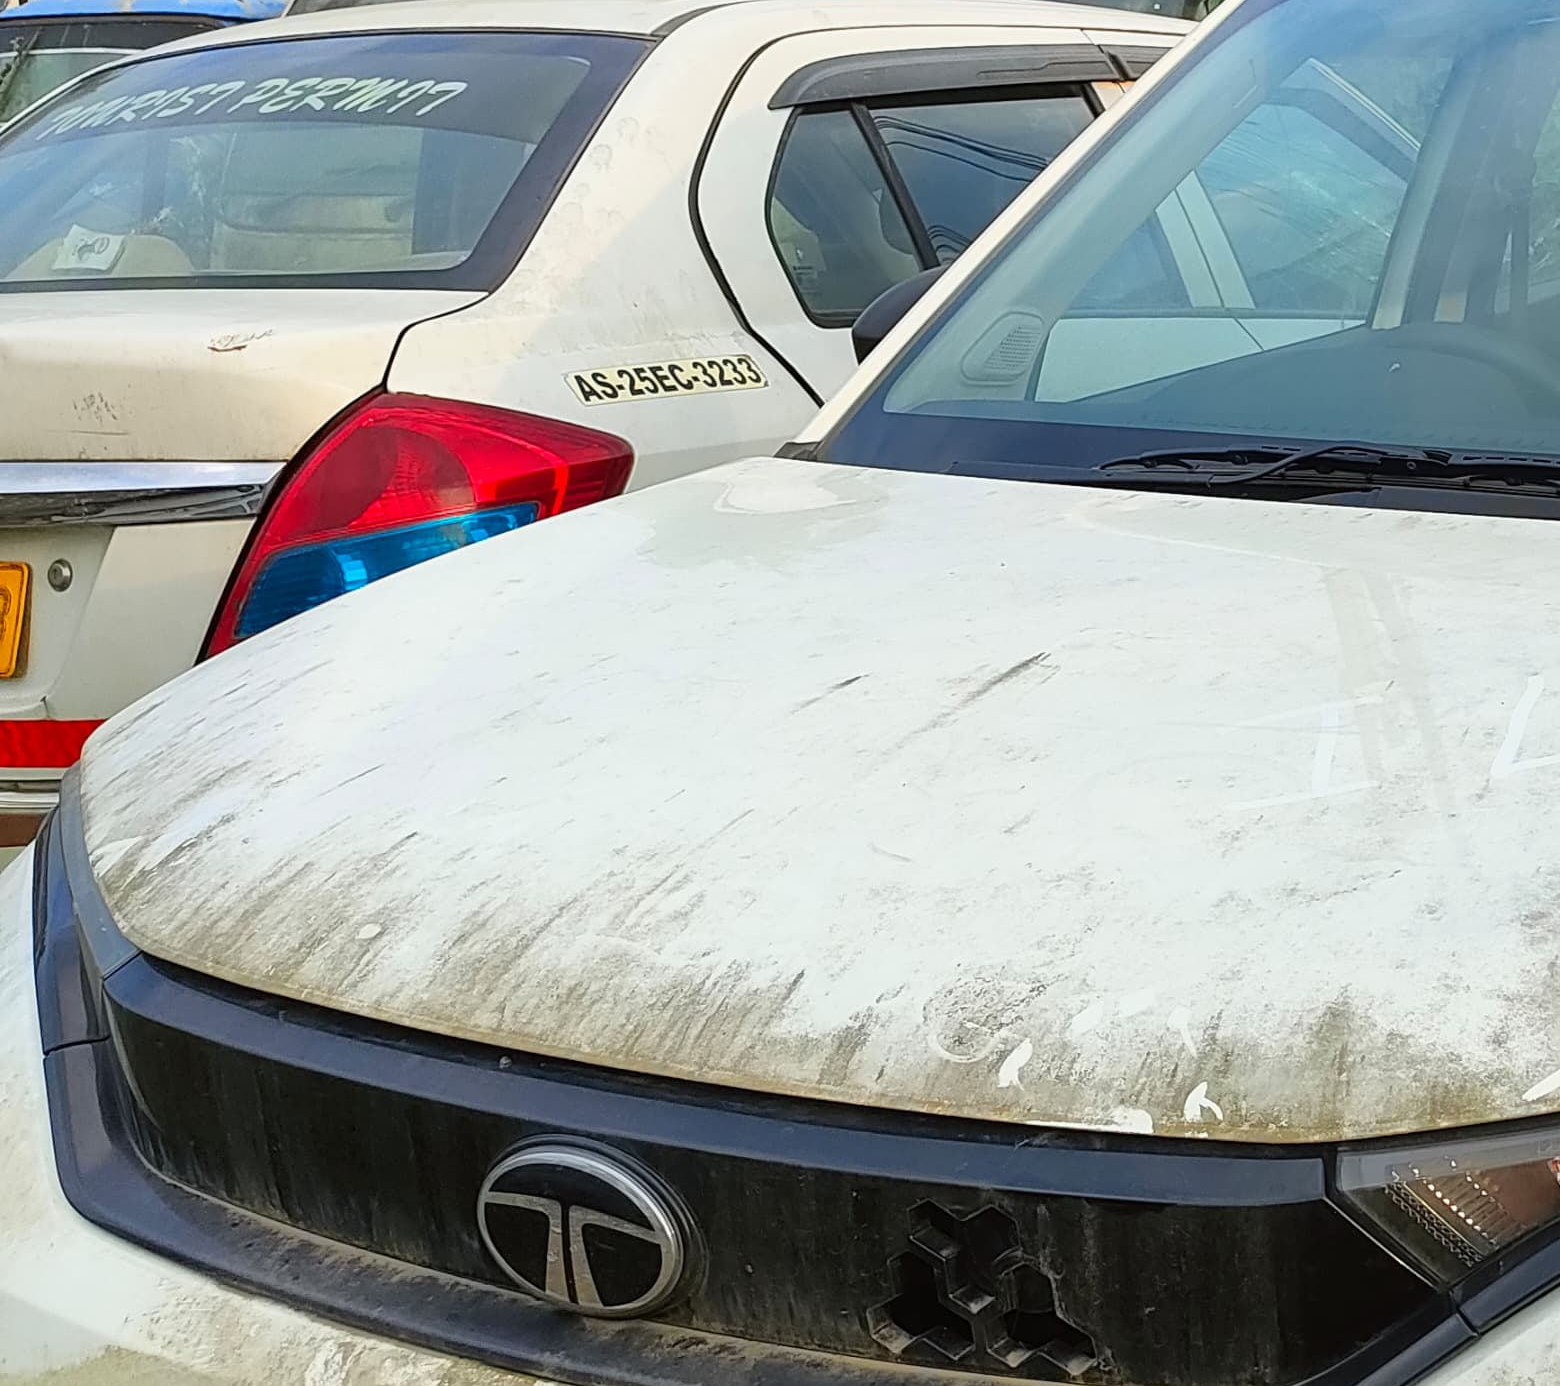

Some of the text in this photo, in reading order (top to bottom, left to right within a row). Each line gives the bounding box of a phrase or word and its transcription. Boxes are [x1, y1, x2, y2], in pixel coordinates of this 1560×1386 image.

[34, 77, 469, 142] TOURIST PERMIT
[573, 357, 763, 403] AS-25EC-3233
